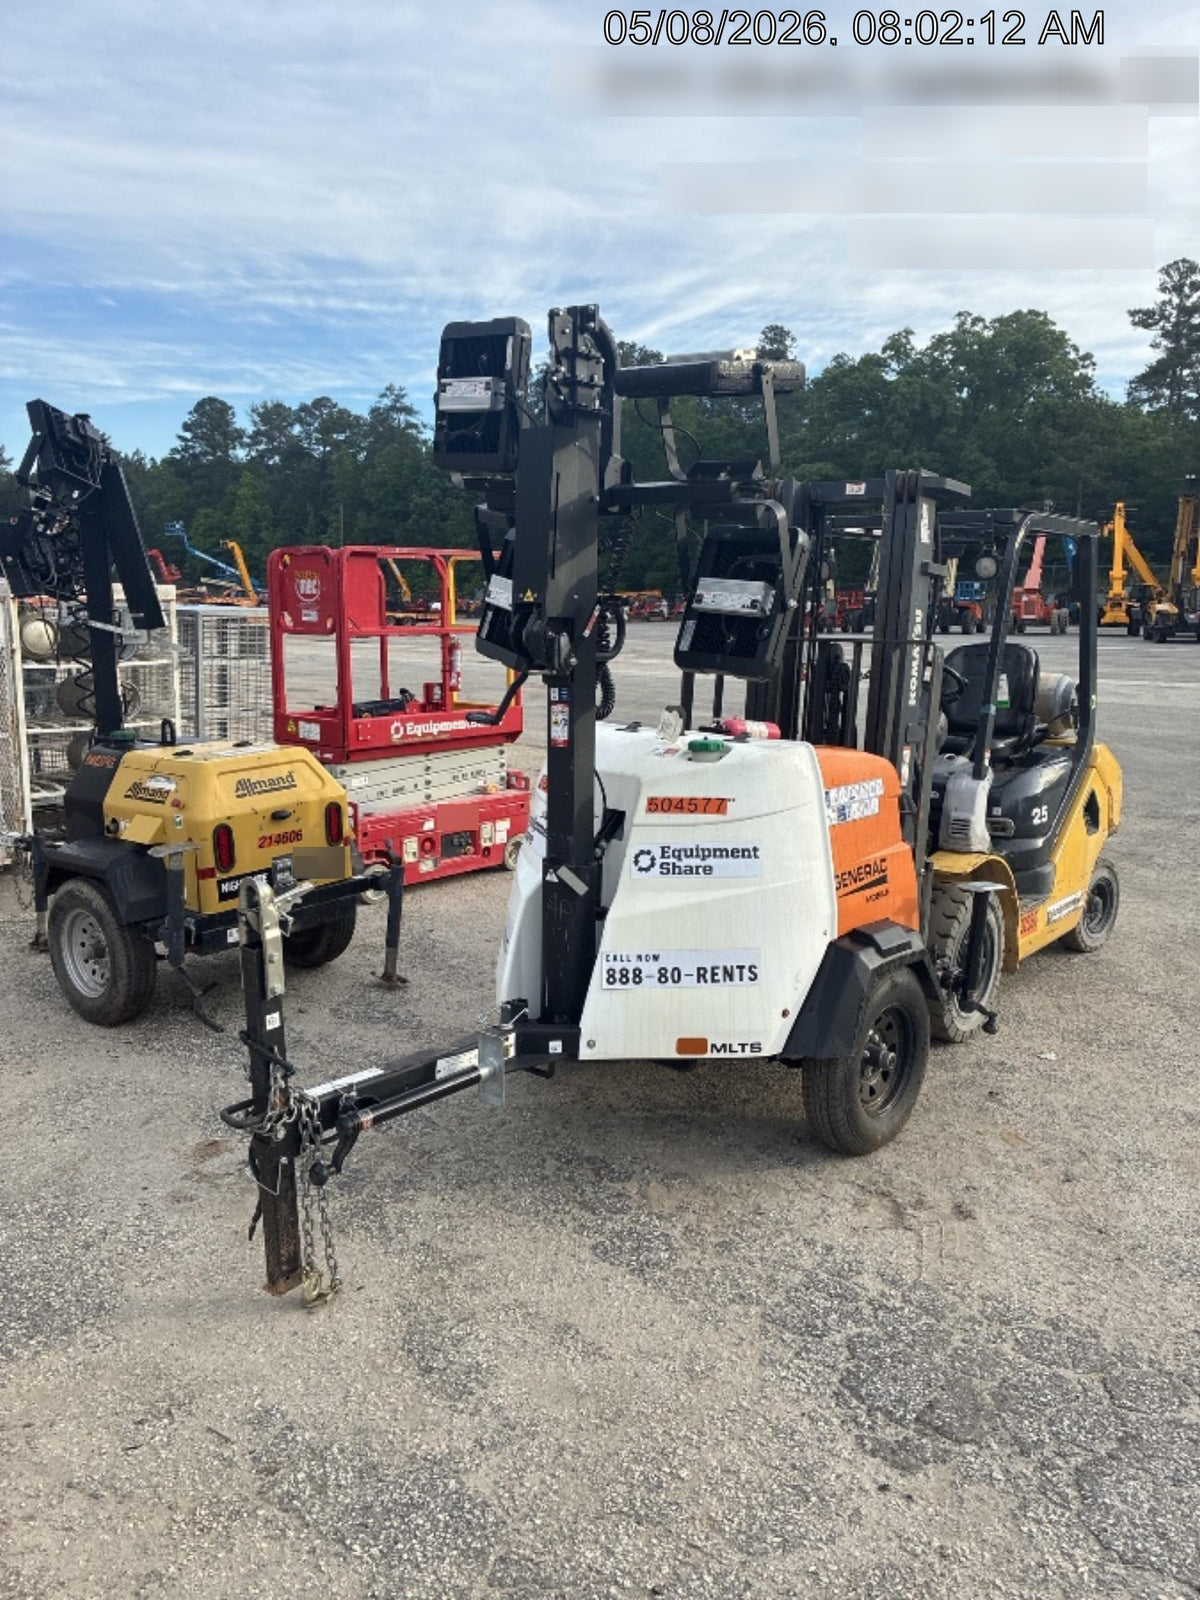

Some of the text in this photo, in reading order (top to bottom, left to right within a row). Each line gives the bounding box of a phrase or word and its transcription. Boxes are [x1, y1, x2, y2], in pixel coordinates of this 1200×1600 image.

[647, 797, 727, 813] 504577
[1030, 805, 1048, 825] 25
[659, 844, 760, 862] Equipment
[659, 861, 713, 876] Share
[605, 953, 660, 962] CALL NOW
[605, 964, 758, 985] 888-80-RENTS
[710, 1042, 762, 1054] MLTS
